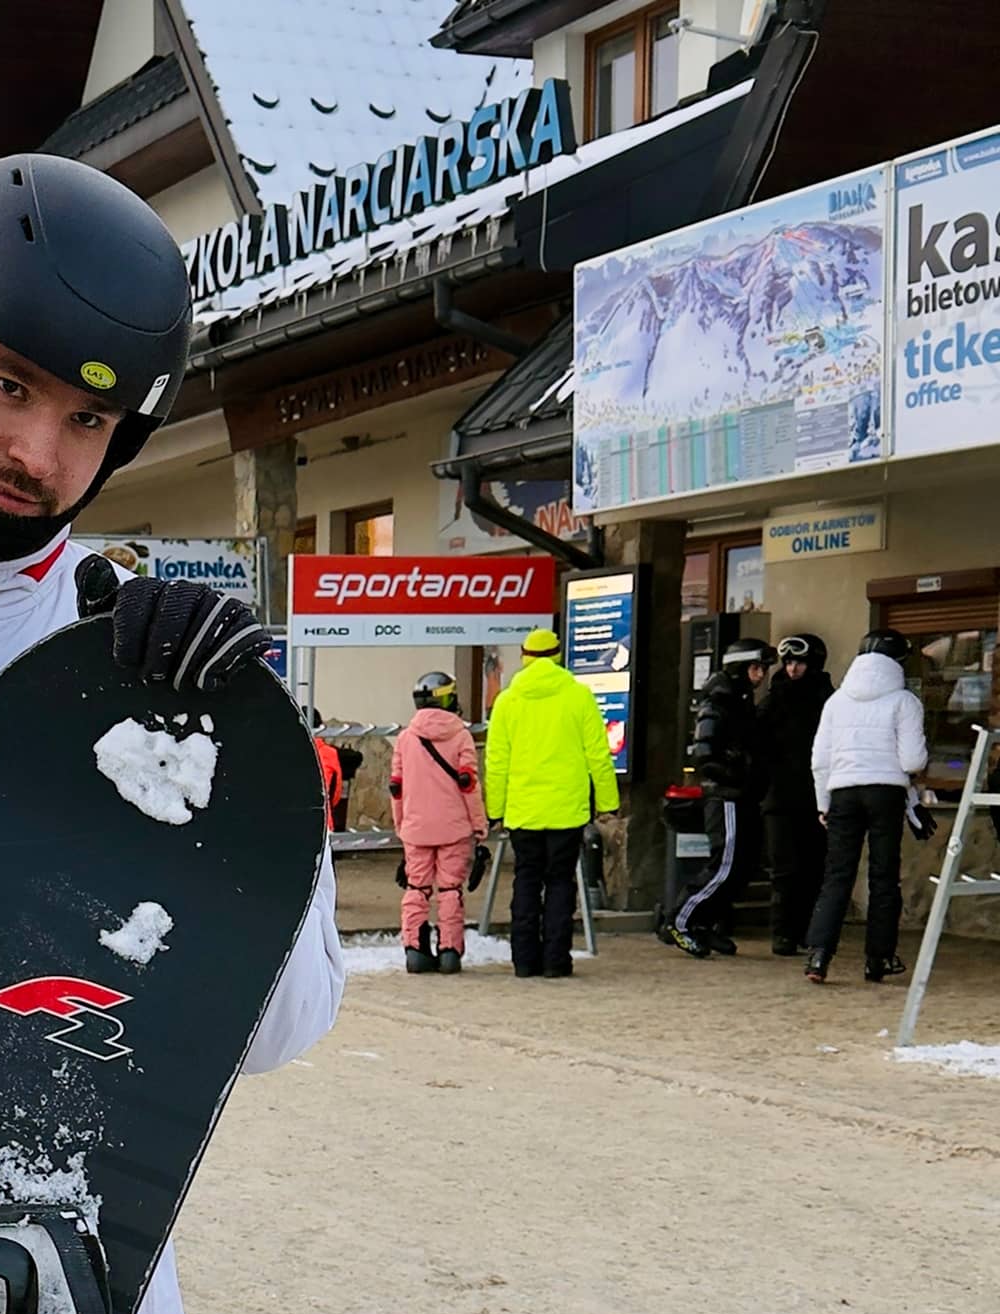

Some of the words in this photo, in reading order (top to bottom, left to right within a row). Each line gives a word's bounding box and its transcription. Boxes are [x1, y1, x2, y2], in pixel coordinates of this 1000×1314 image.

[181, 203, 286, 301] ZKOŁA
[288, 78, 574, 261] NARCIARSKA
[907, 203, 1000, 284] ka
[906, 380, 962, 409] office
[769, 522, 810, 538] ODBIÓR
[813, 512, 876, 533] KARNETÓW
[792, 531, 851, 553] ONLINE
[315, 566, 535, 606] sportano.pl
[304, 627, 350, 636] HEAD
